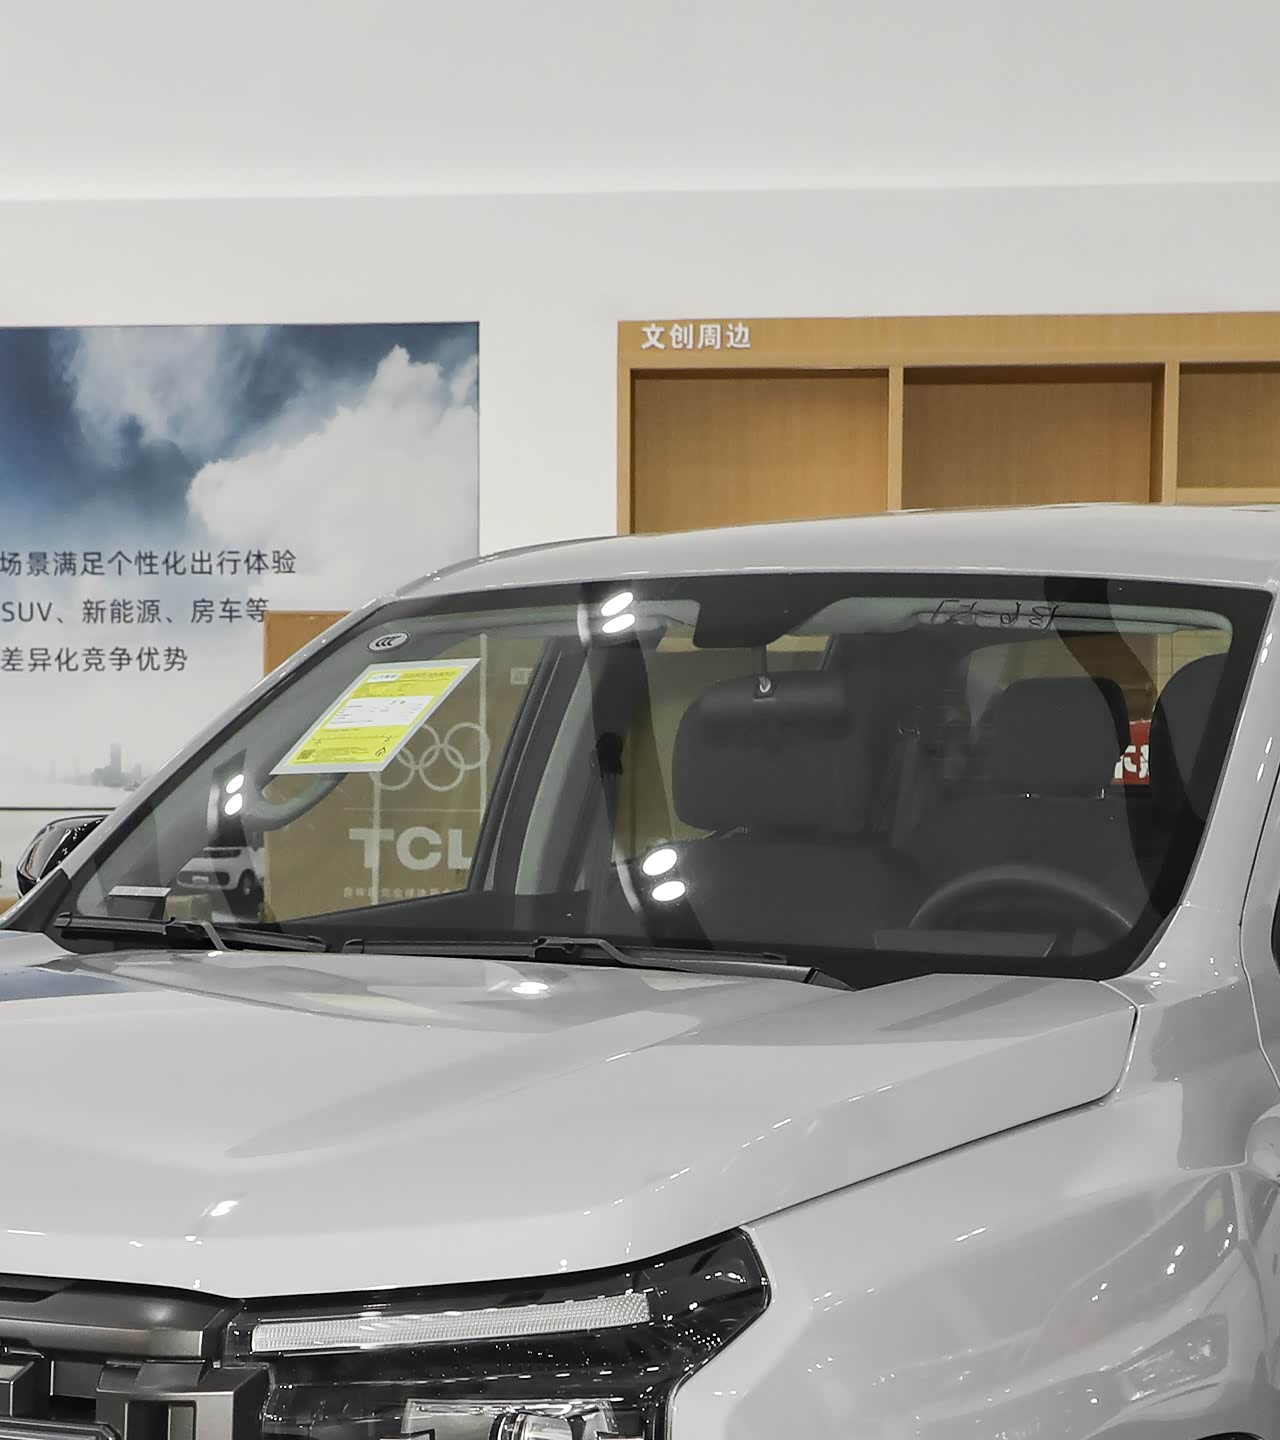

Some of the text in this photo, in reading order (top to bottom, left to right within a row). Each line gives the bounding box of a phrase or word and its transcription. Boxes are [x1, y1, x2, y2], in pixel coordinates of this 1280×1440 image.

[641, 322, 752, 351] 文创周边
[349, 826, 474, 871] TCL
